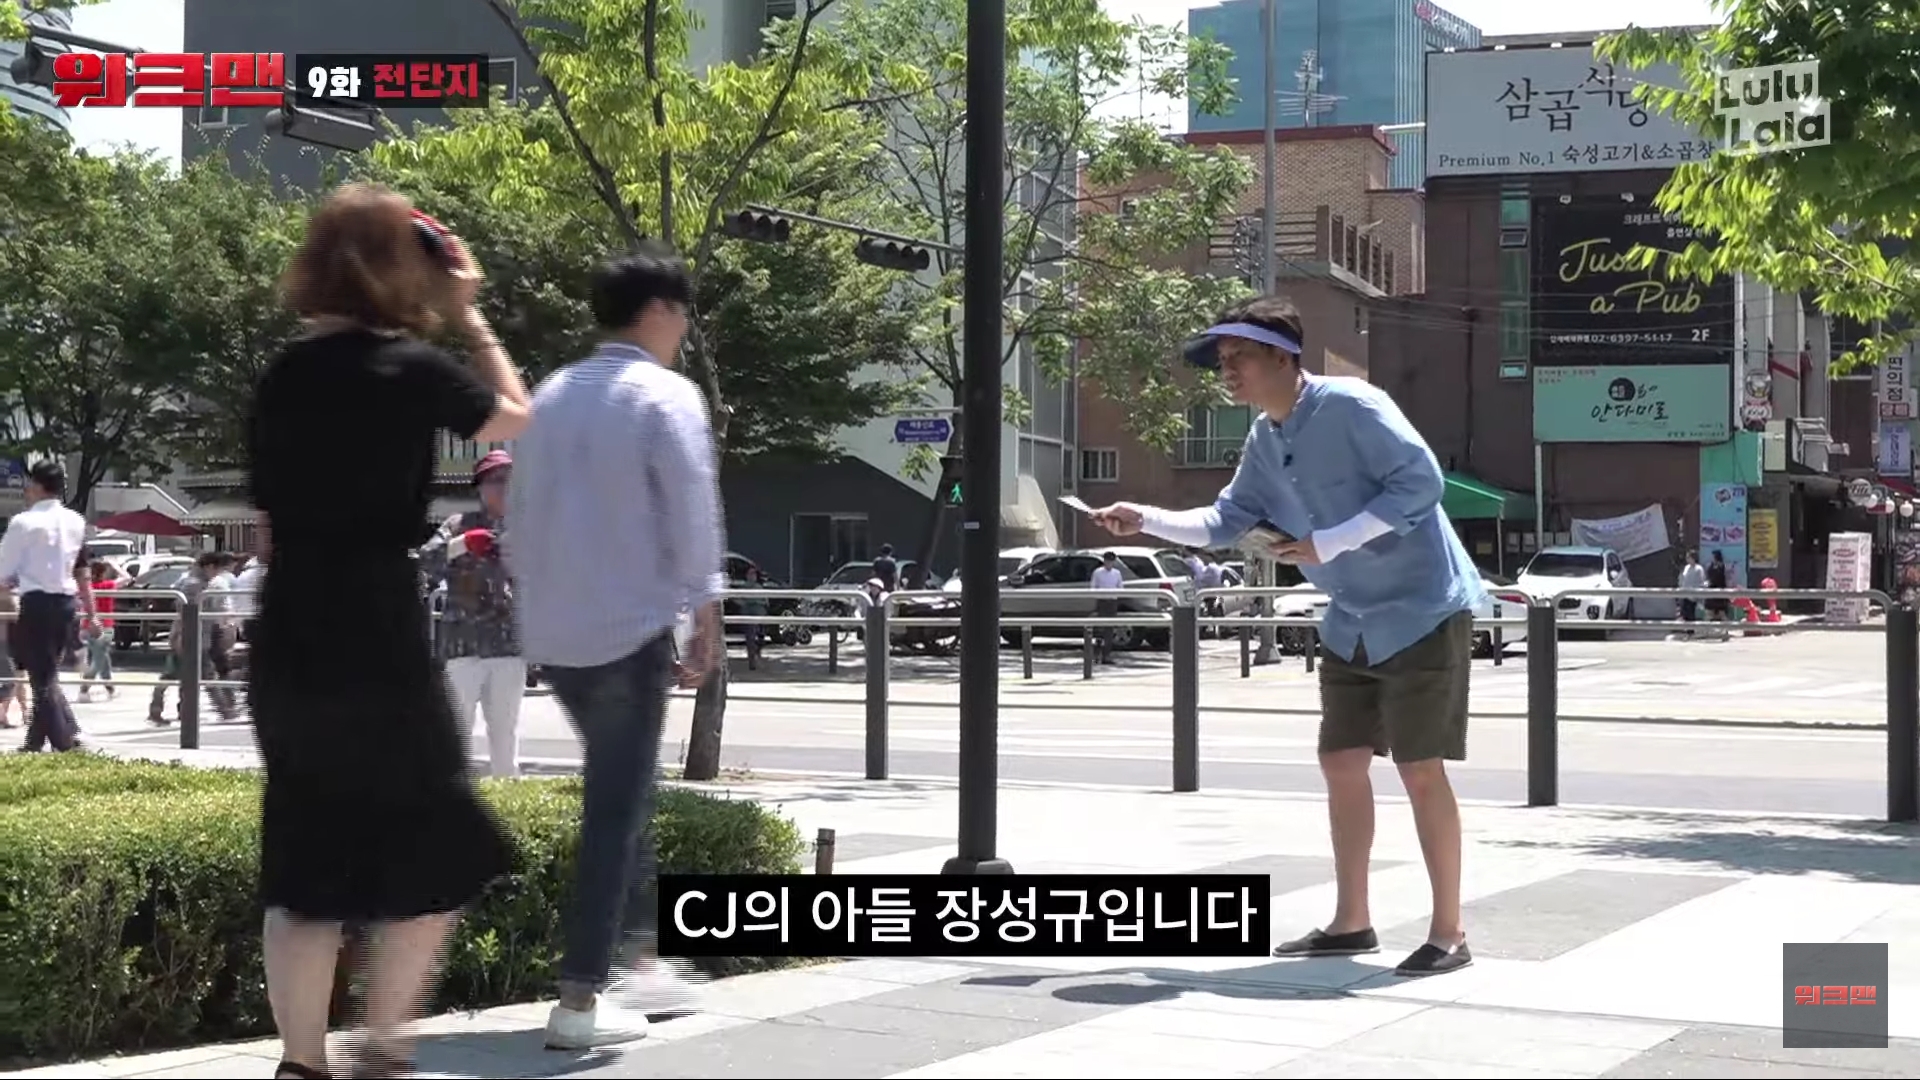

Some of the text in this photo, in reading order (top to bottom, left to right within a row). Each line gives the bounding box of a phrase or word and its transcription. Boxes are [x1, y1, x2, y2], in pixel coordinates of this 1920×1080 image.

[1439, 153, 1511, 168] Premium
[1589, 280, 1701, 314] a Pub
[1691, 328, 1711, 342] 2F
